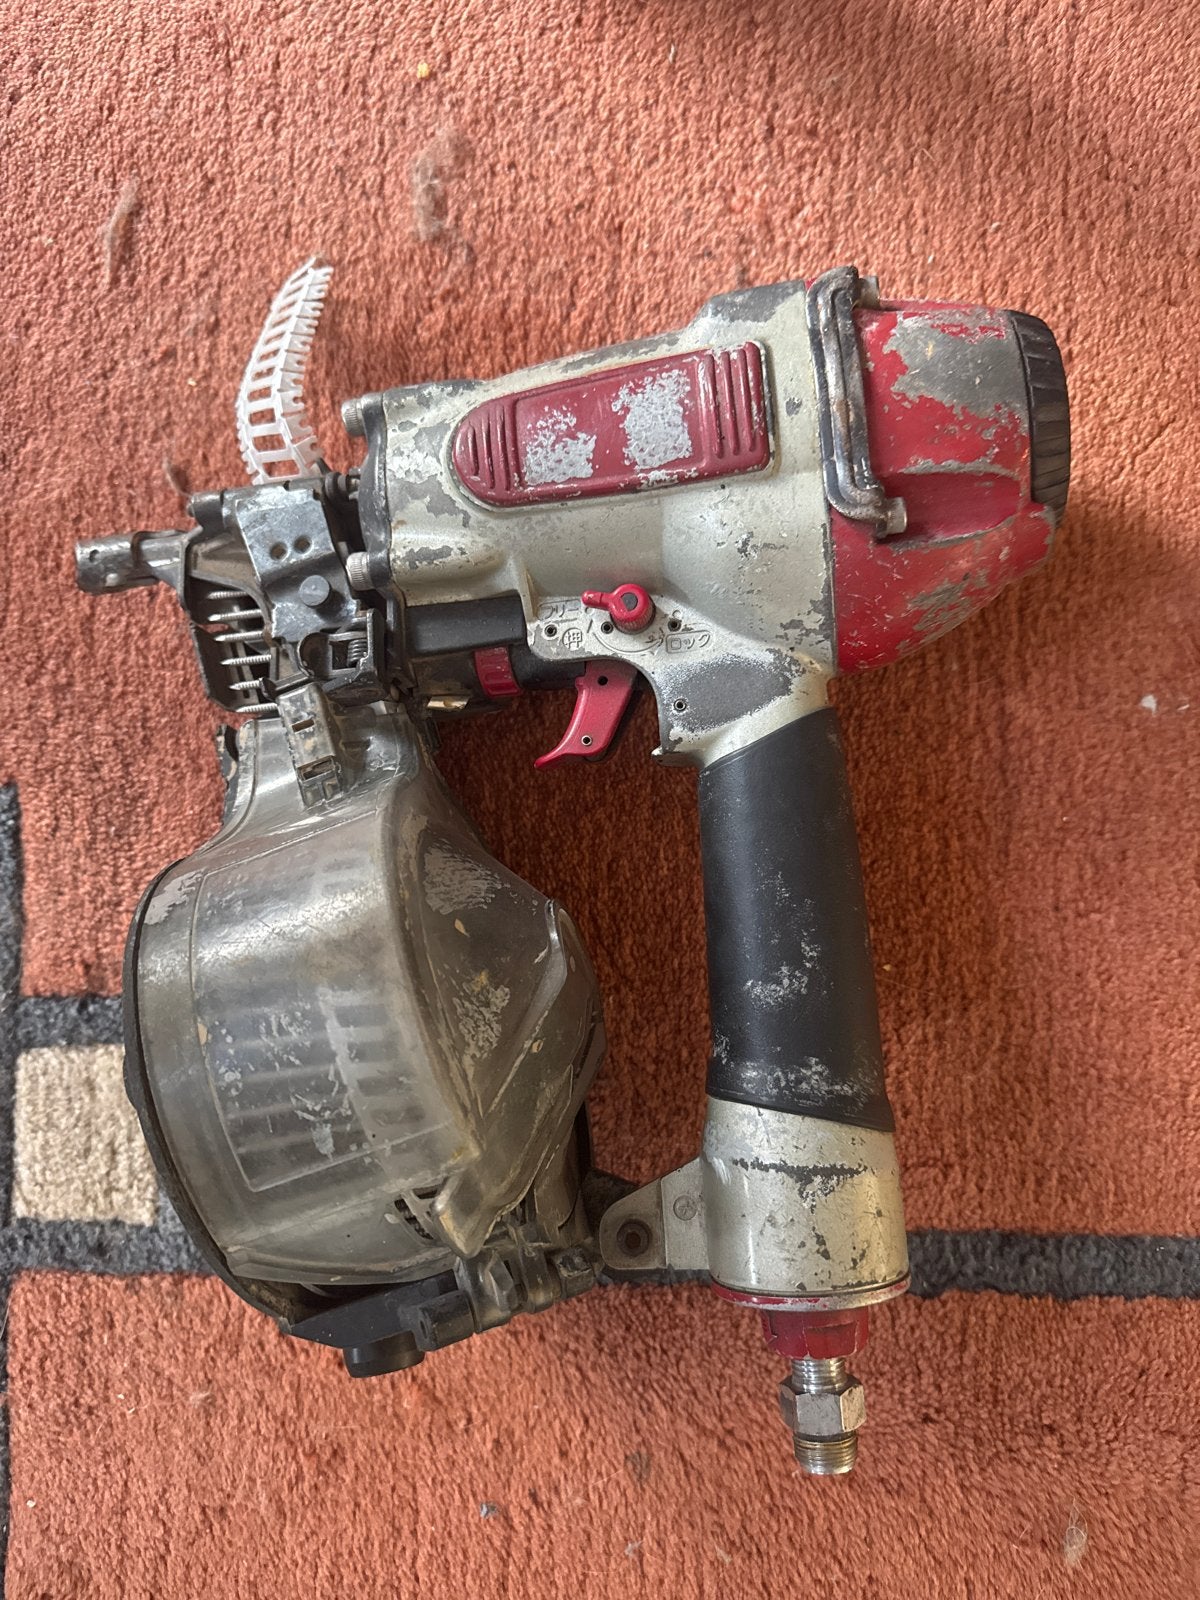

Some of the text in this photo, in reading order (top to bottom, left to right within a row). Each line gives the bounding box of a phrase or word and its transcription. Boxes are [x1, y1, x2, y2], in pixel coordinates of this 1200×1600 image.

[541, 604, 579, 619] フリー
[671, 634, 711, 650] ロック
